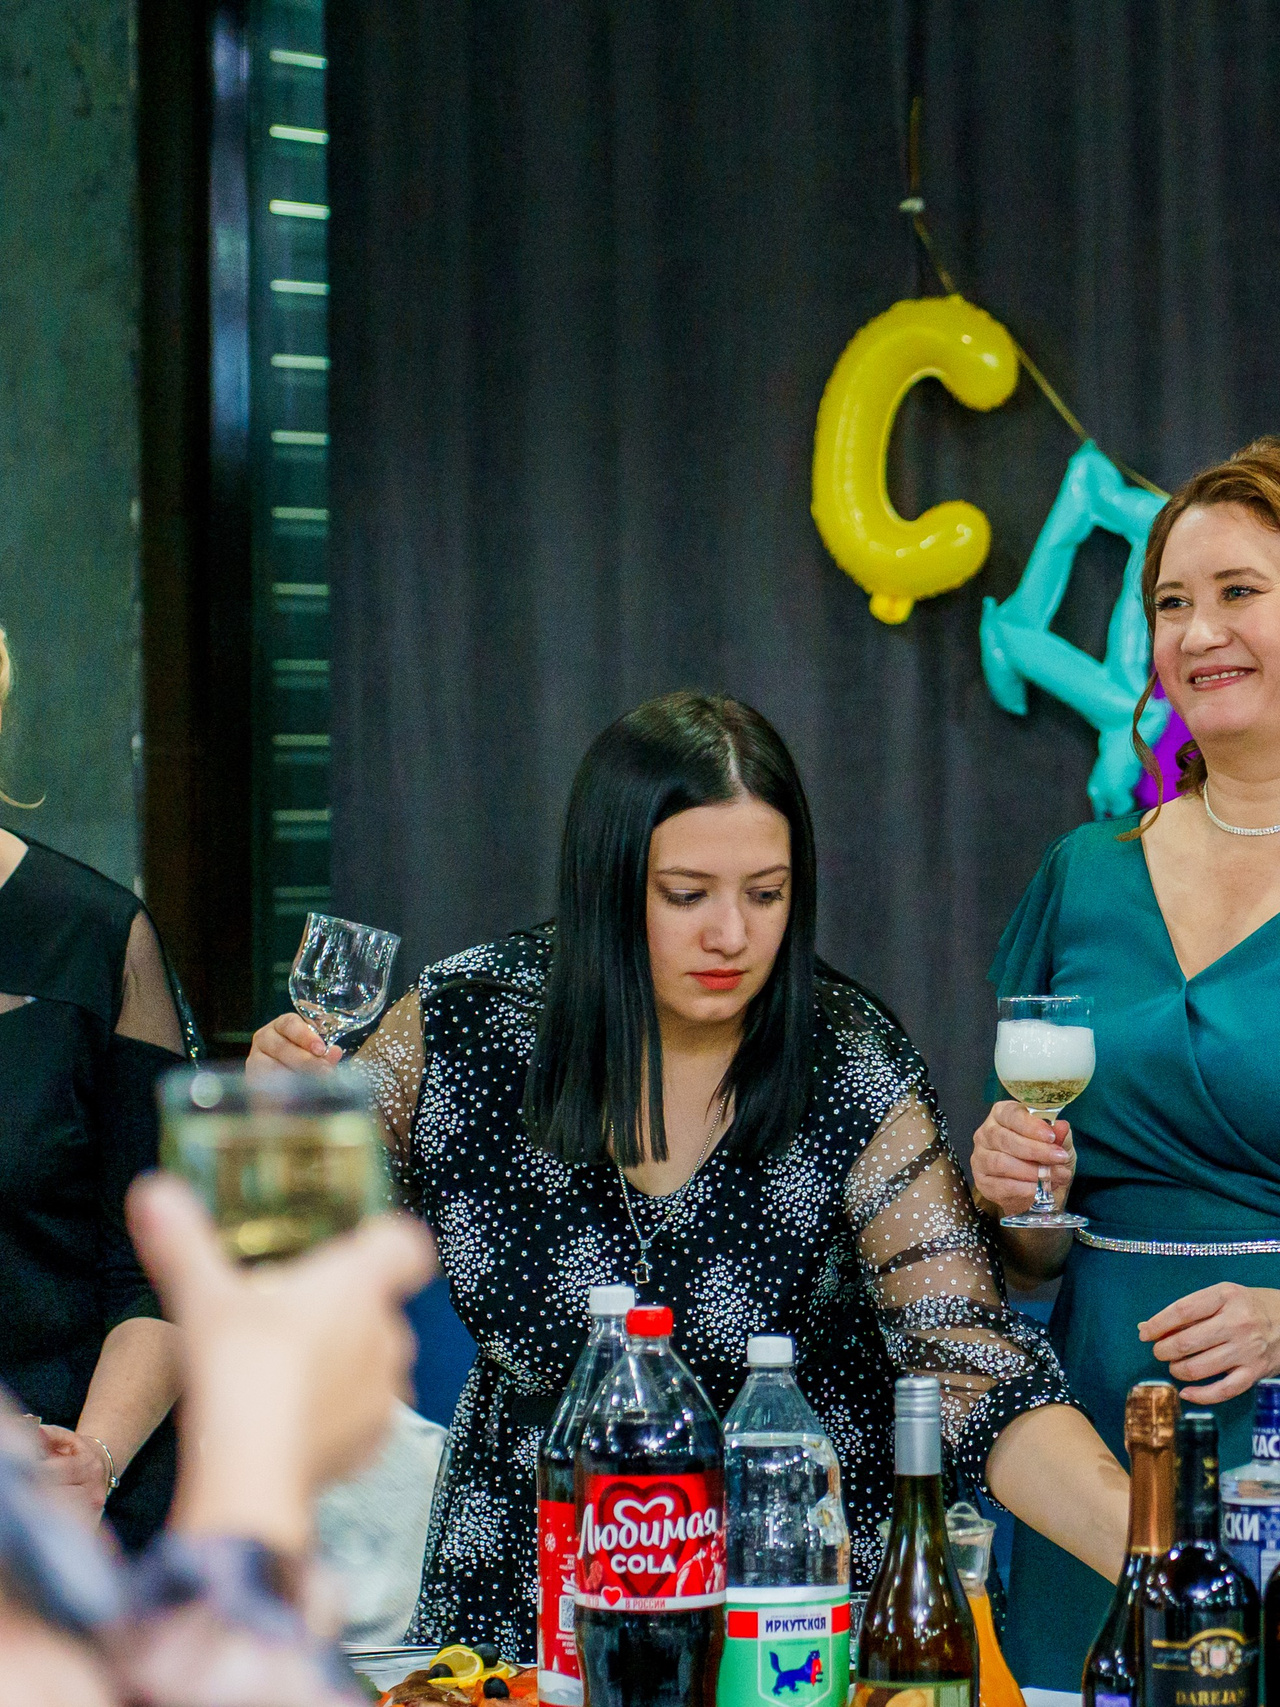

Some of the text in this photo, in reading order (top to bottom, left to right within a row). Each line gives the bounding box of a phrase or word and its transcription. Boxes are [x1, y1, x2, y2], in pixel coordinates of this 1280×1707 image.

[577, 1496, 718, 1559] Любимая
[611, 1553, 676, 1574] COLA
[625, 1599, 631, 1609] В
[632, 1599, 666, 1610] РОССИИ
[765, 1617, 827, 1633] ИРКУТСКАЯ
